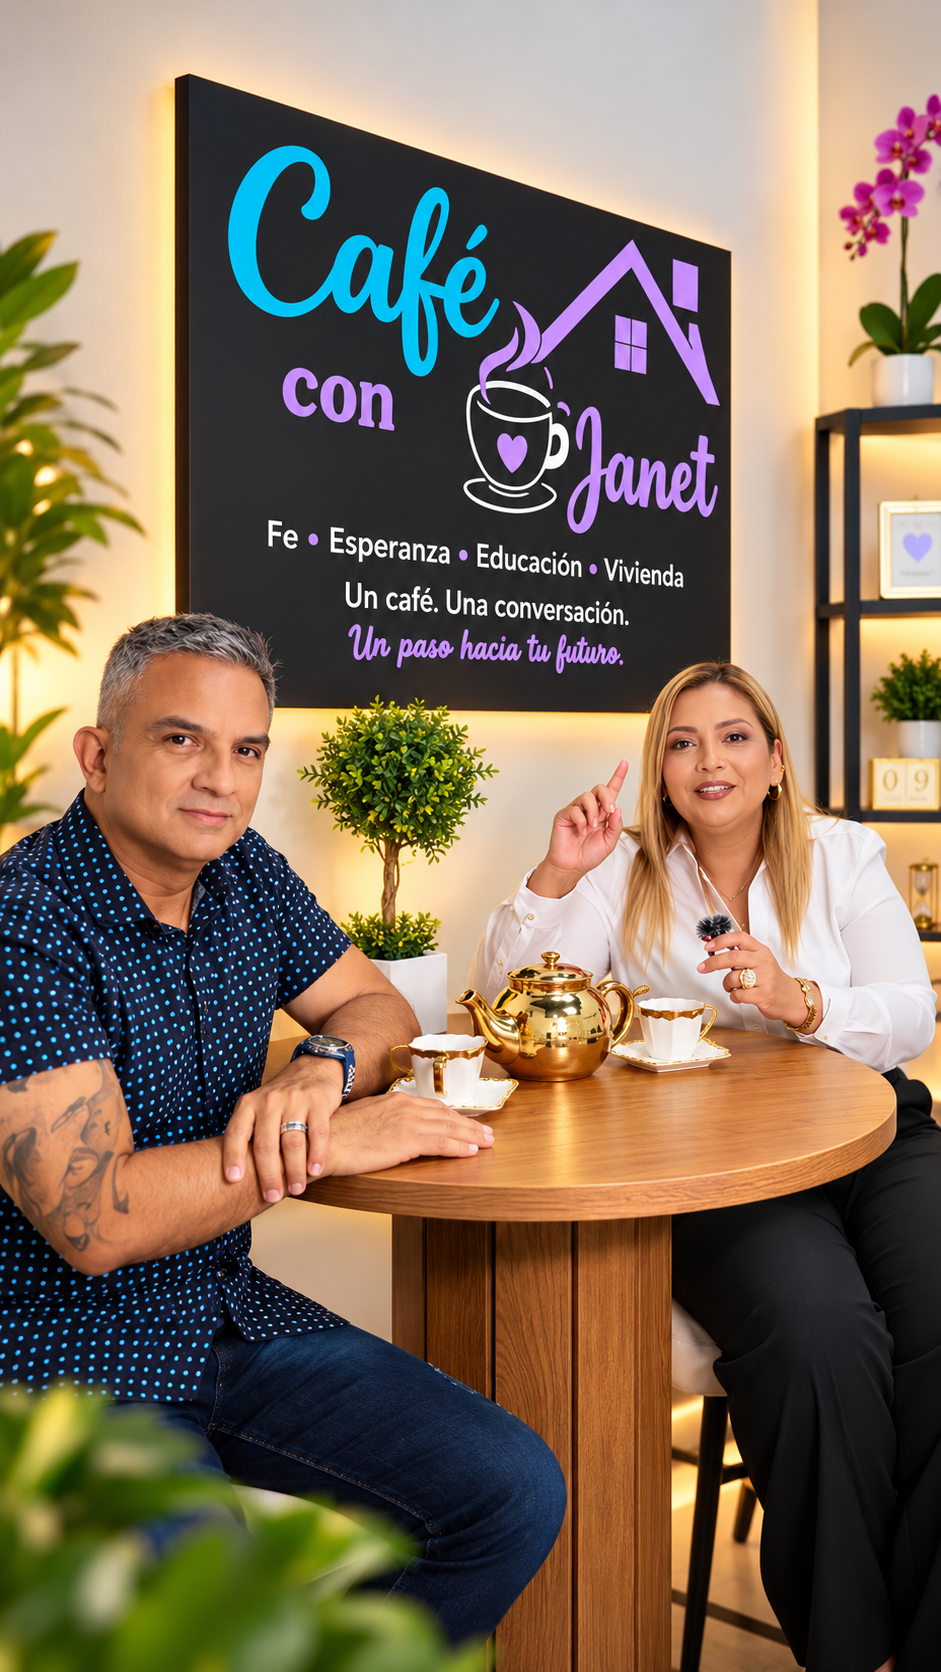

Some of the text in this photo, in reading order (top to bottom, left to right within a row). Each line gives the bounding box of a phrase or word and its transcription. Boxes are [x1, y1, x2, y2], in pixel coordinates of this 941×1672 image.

[227, 145, 499, 376] Café
[283, 367, 395, 431] con
[566, 406, 719, 533] Janet
[267, 519, 684, 588] Fe Esperanza Educación Vivienda
[345, 581, 630, 626] Un café. Una conversación.
[347, 623, 624, 675] Un paso hacia tu futuro.
